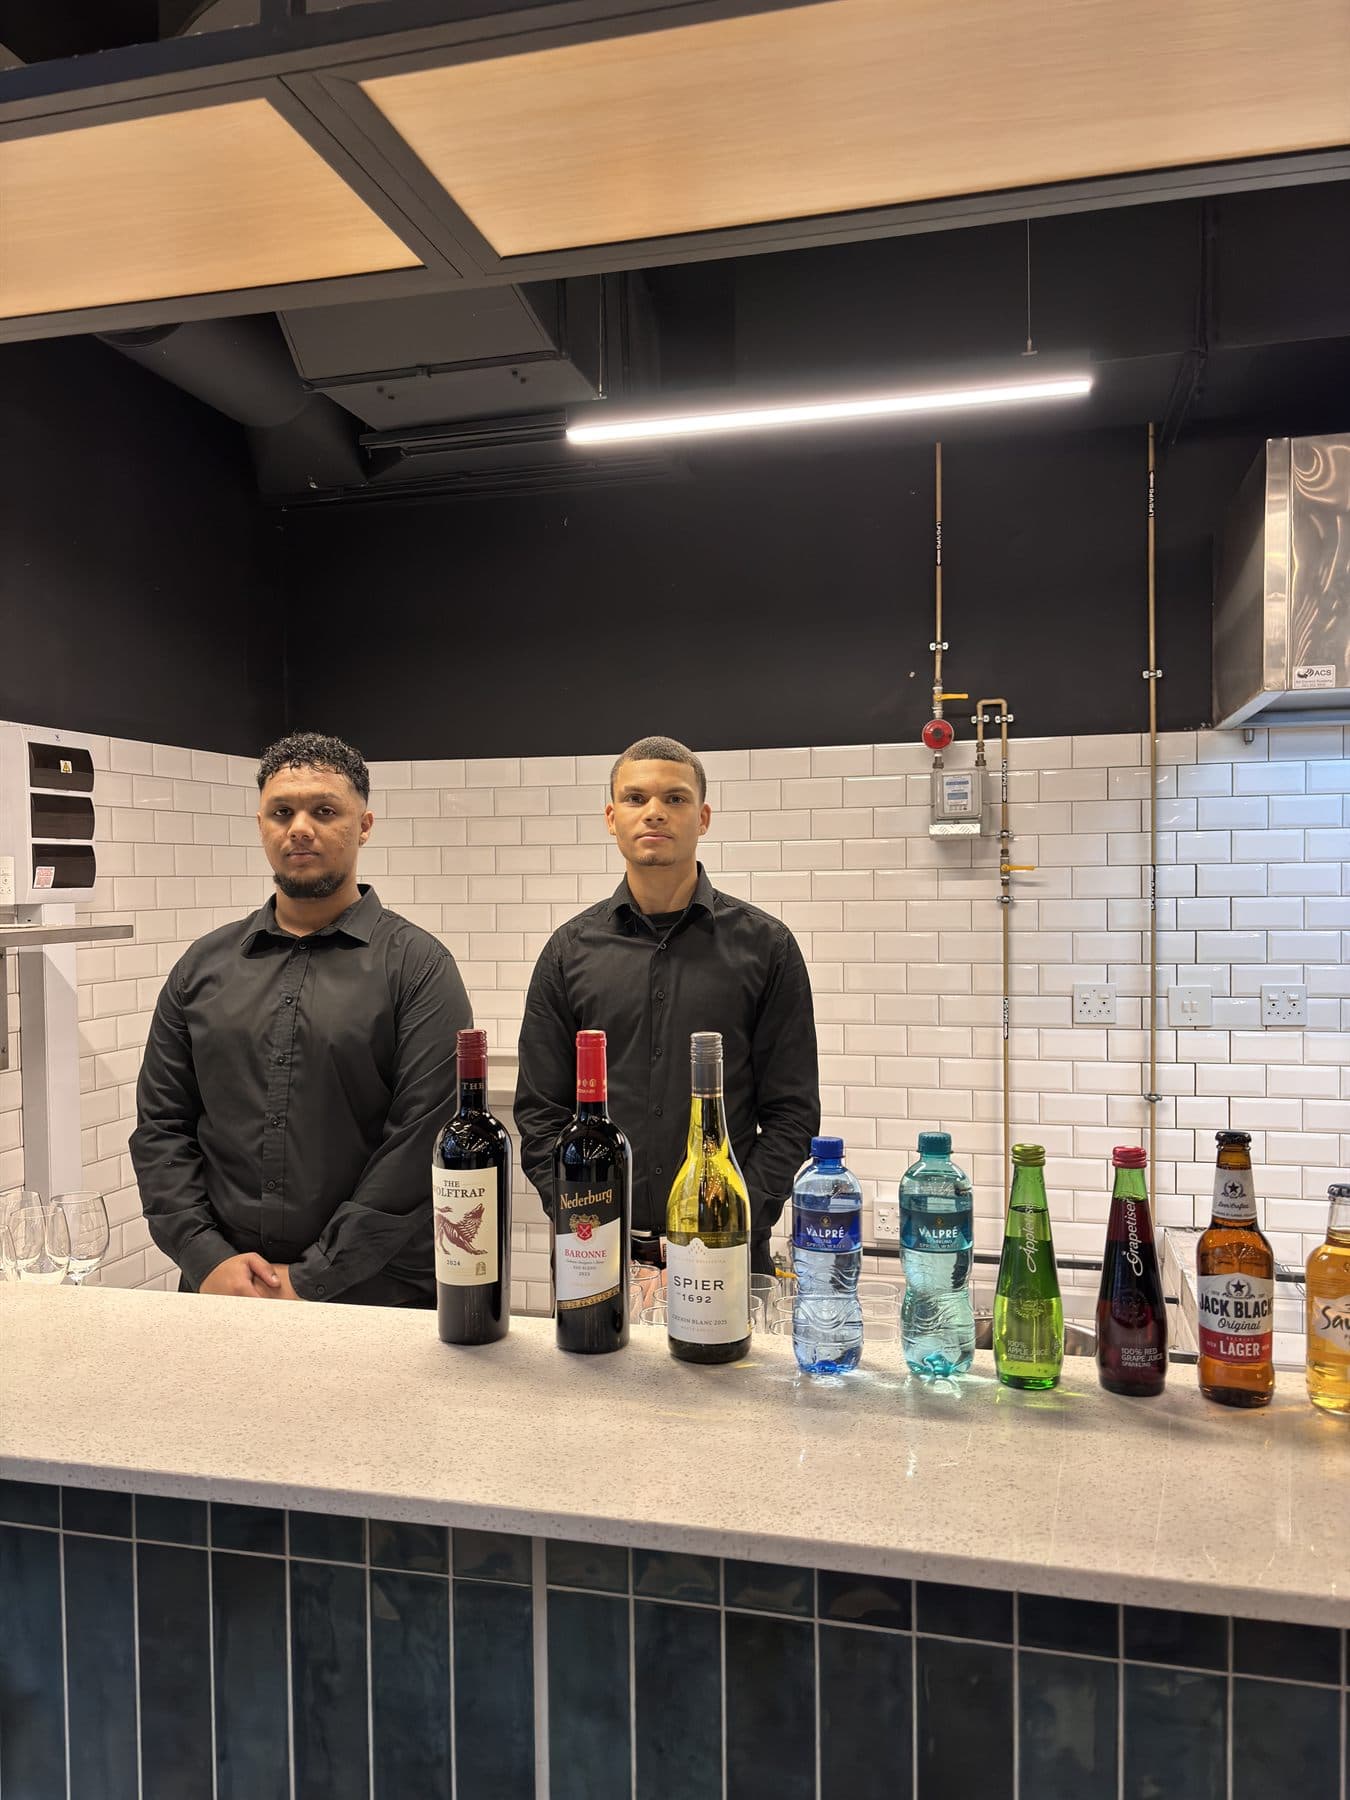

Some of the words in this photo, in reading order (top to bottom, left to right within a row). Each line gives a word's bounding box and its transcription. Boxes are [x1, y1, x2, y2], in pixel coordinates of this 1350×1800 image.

[462, 1082, 485, 1090] THE
[443, 1180, 460, 1188] THE
[560, 1188, 613, 1210] Nederburg
[806, 1225, 845, 1239] VALPRÉ
[918, 1225, 959, 1239] VALPRÉ
[564, 1249, 608, 1259] BARONNE
[673, 1275, 724, 1291] SPIER
[682, 1294, 712, 1304] 1692
[1200, 1293, 1230, 1318] JACK
[1234, 1297, 1273, 1319] BLACK
[1218, 1318, 1261, 1332] Original
[1220, 1340, 1260, 1357] LAGER
